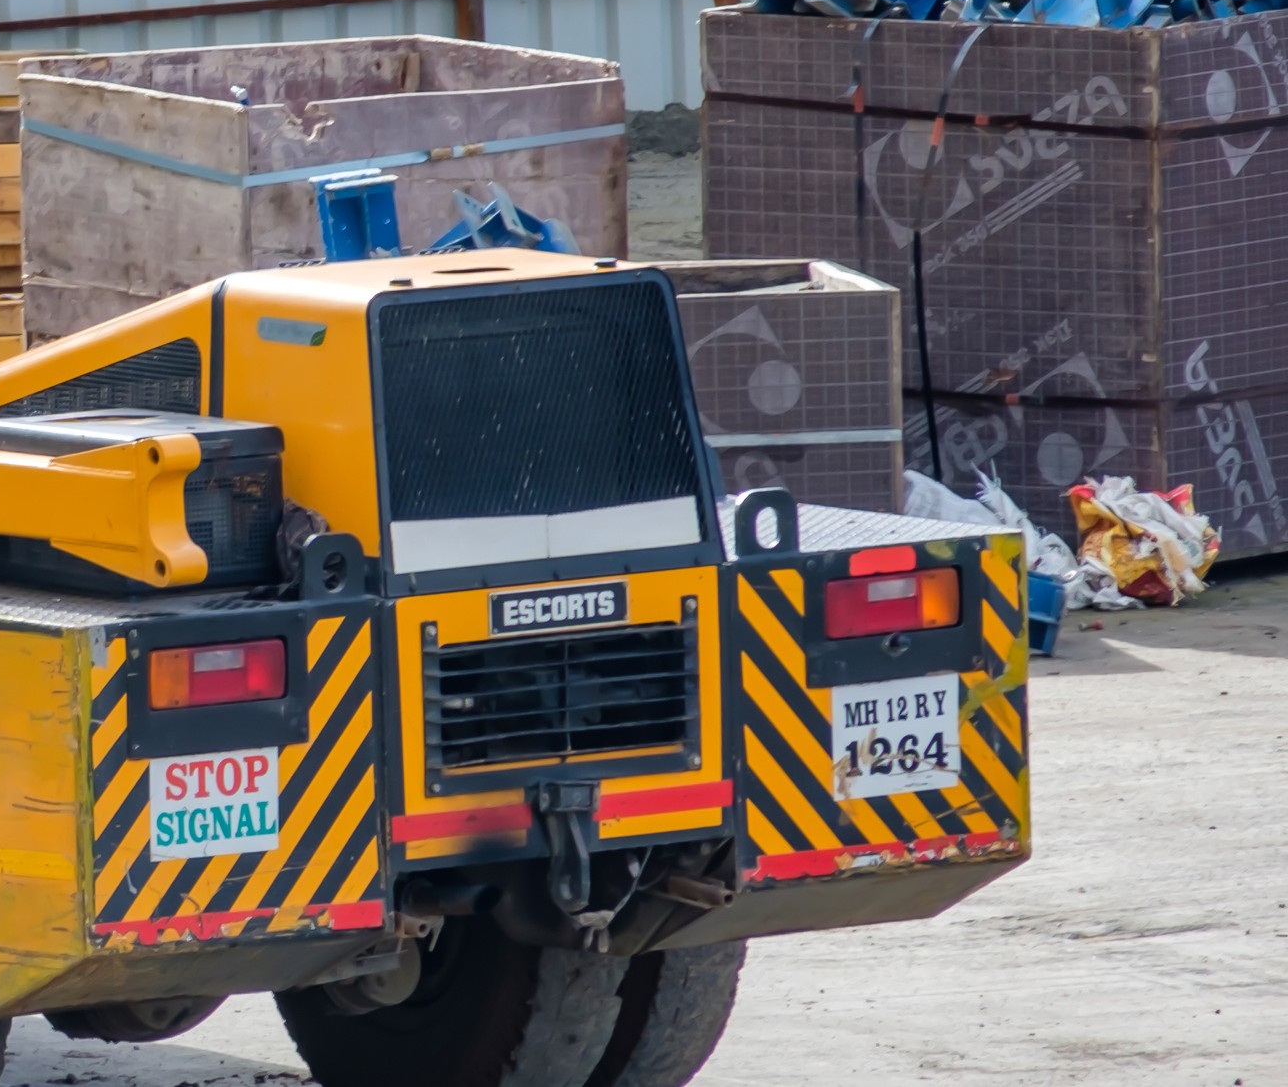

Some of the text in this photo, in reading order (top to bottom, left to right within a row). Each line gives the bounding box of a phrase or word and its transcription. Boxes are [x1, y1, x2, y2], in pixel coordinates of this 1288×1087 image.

[503, 590, 615, 627] ESCORTS
[844, 699, 879, 728] MH
[886, 696, 908, 723] 12
[164, 754, 270, 802] STOP
[844, 731, 950, 778] 1264
[156, 801, 277, 848] SIGNAL
